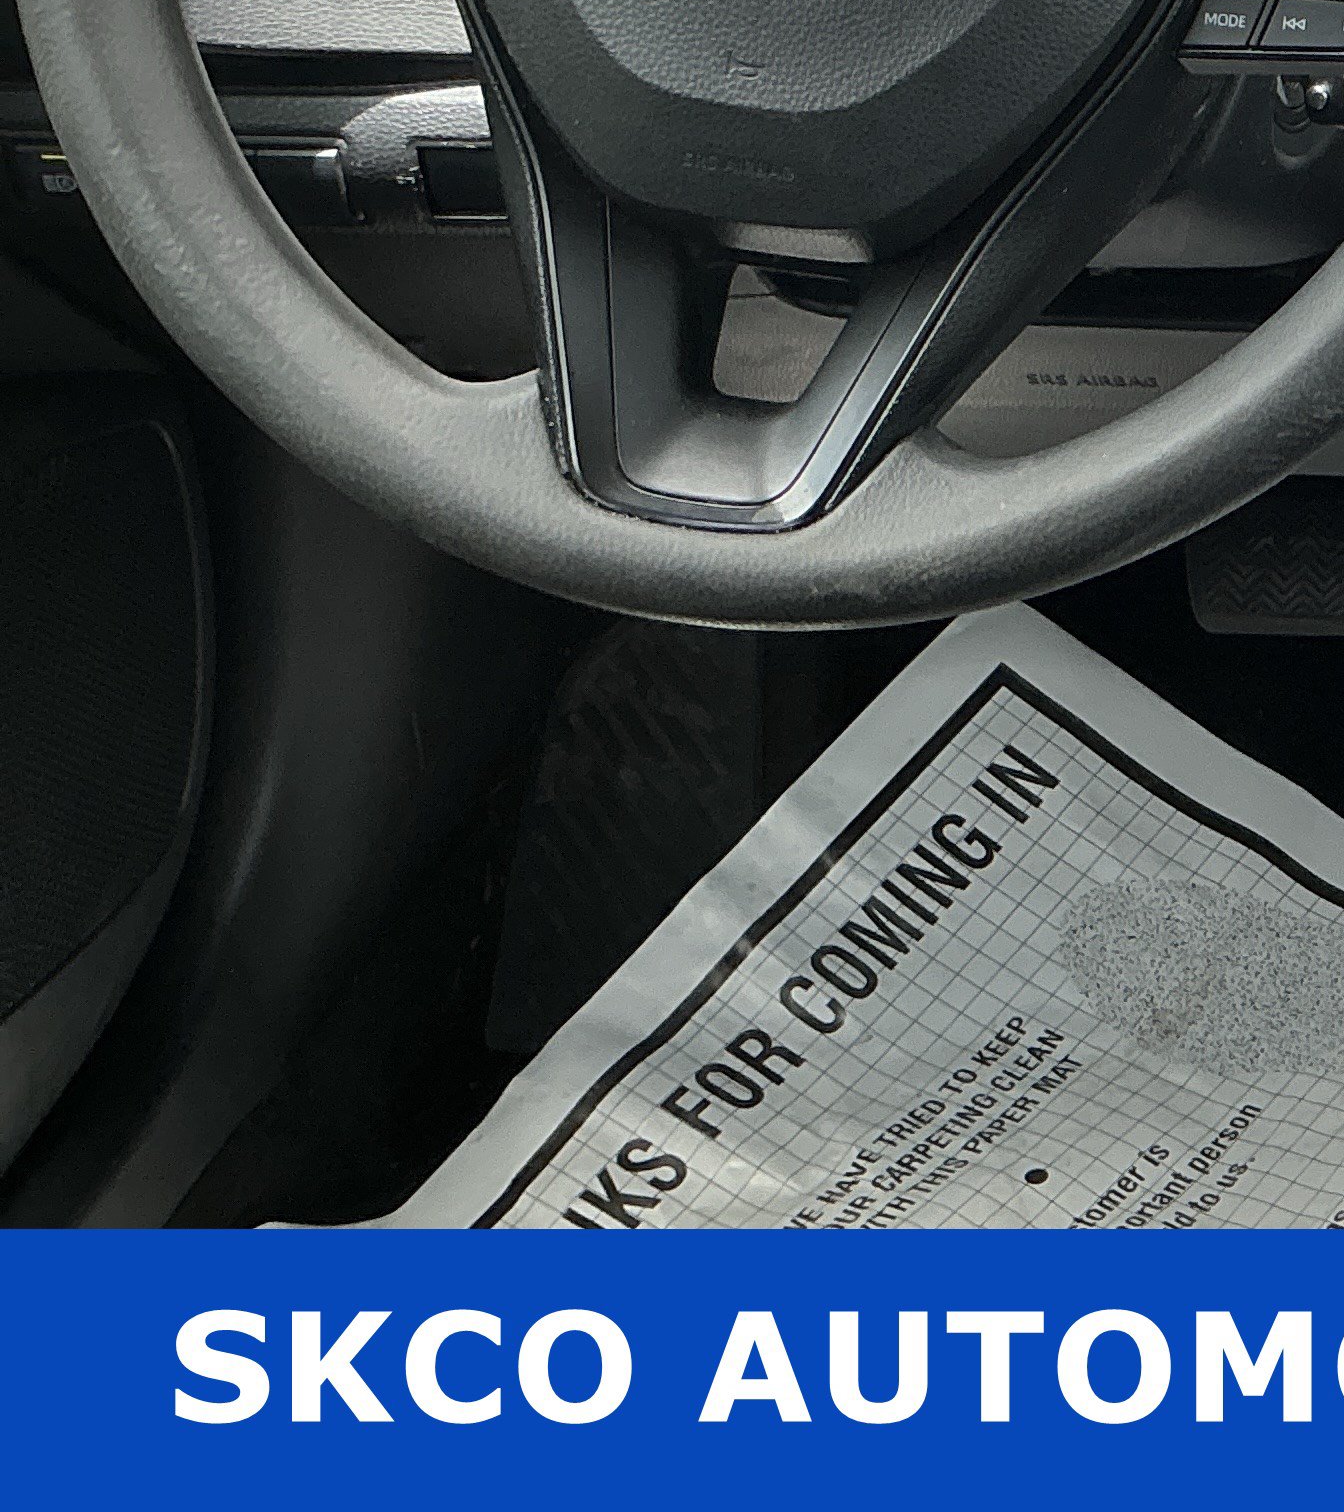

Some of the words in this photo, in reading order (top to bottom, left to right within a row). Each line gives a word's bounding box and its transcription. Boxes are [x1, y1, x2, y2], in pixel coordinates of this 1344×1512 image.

[1204, 12, 1246, 29] MODE
[1026, 373, 1068, 386] SRS
[660, 1028, 805, 1138] FOR
[780, 814, 1002, 1033] COMING
[971, 744, 1060, 823] IN
[817, 1148, 883, 1205] HAVE
[873, 1099, 947, 1148] TRIED
[938, 1068, 978, 1095] TO
[971, 1016, 1028, 1067] KEEP
[871, 1092, 998, 1194] CARPETING
[990, 1029, 1066, 1093] CLEAN
[908, 1157, 969, 1194] THIS
[963, 1096, 1041, 1156] PAPER
[1031, 1053, 1084, 1095] MAT
[1187, 1103, 1264, 1176] person
[1137, 1144, 1171, 1167] is
[1188, 1192, 1222, 1213] to
